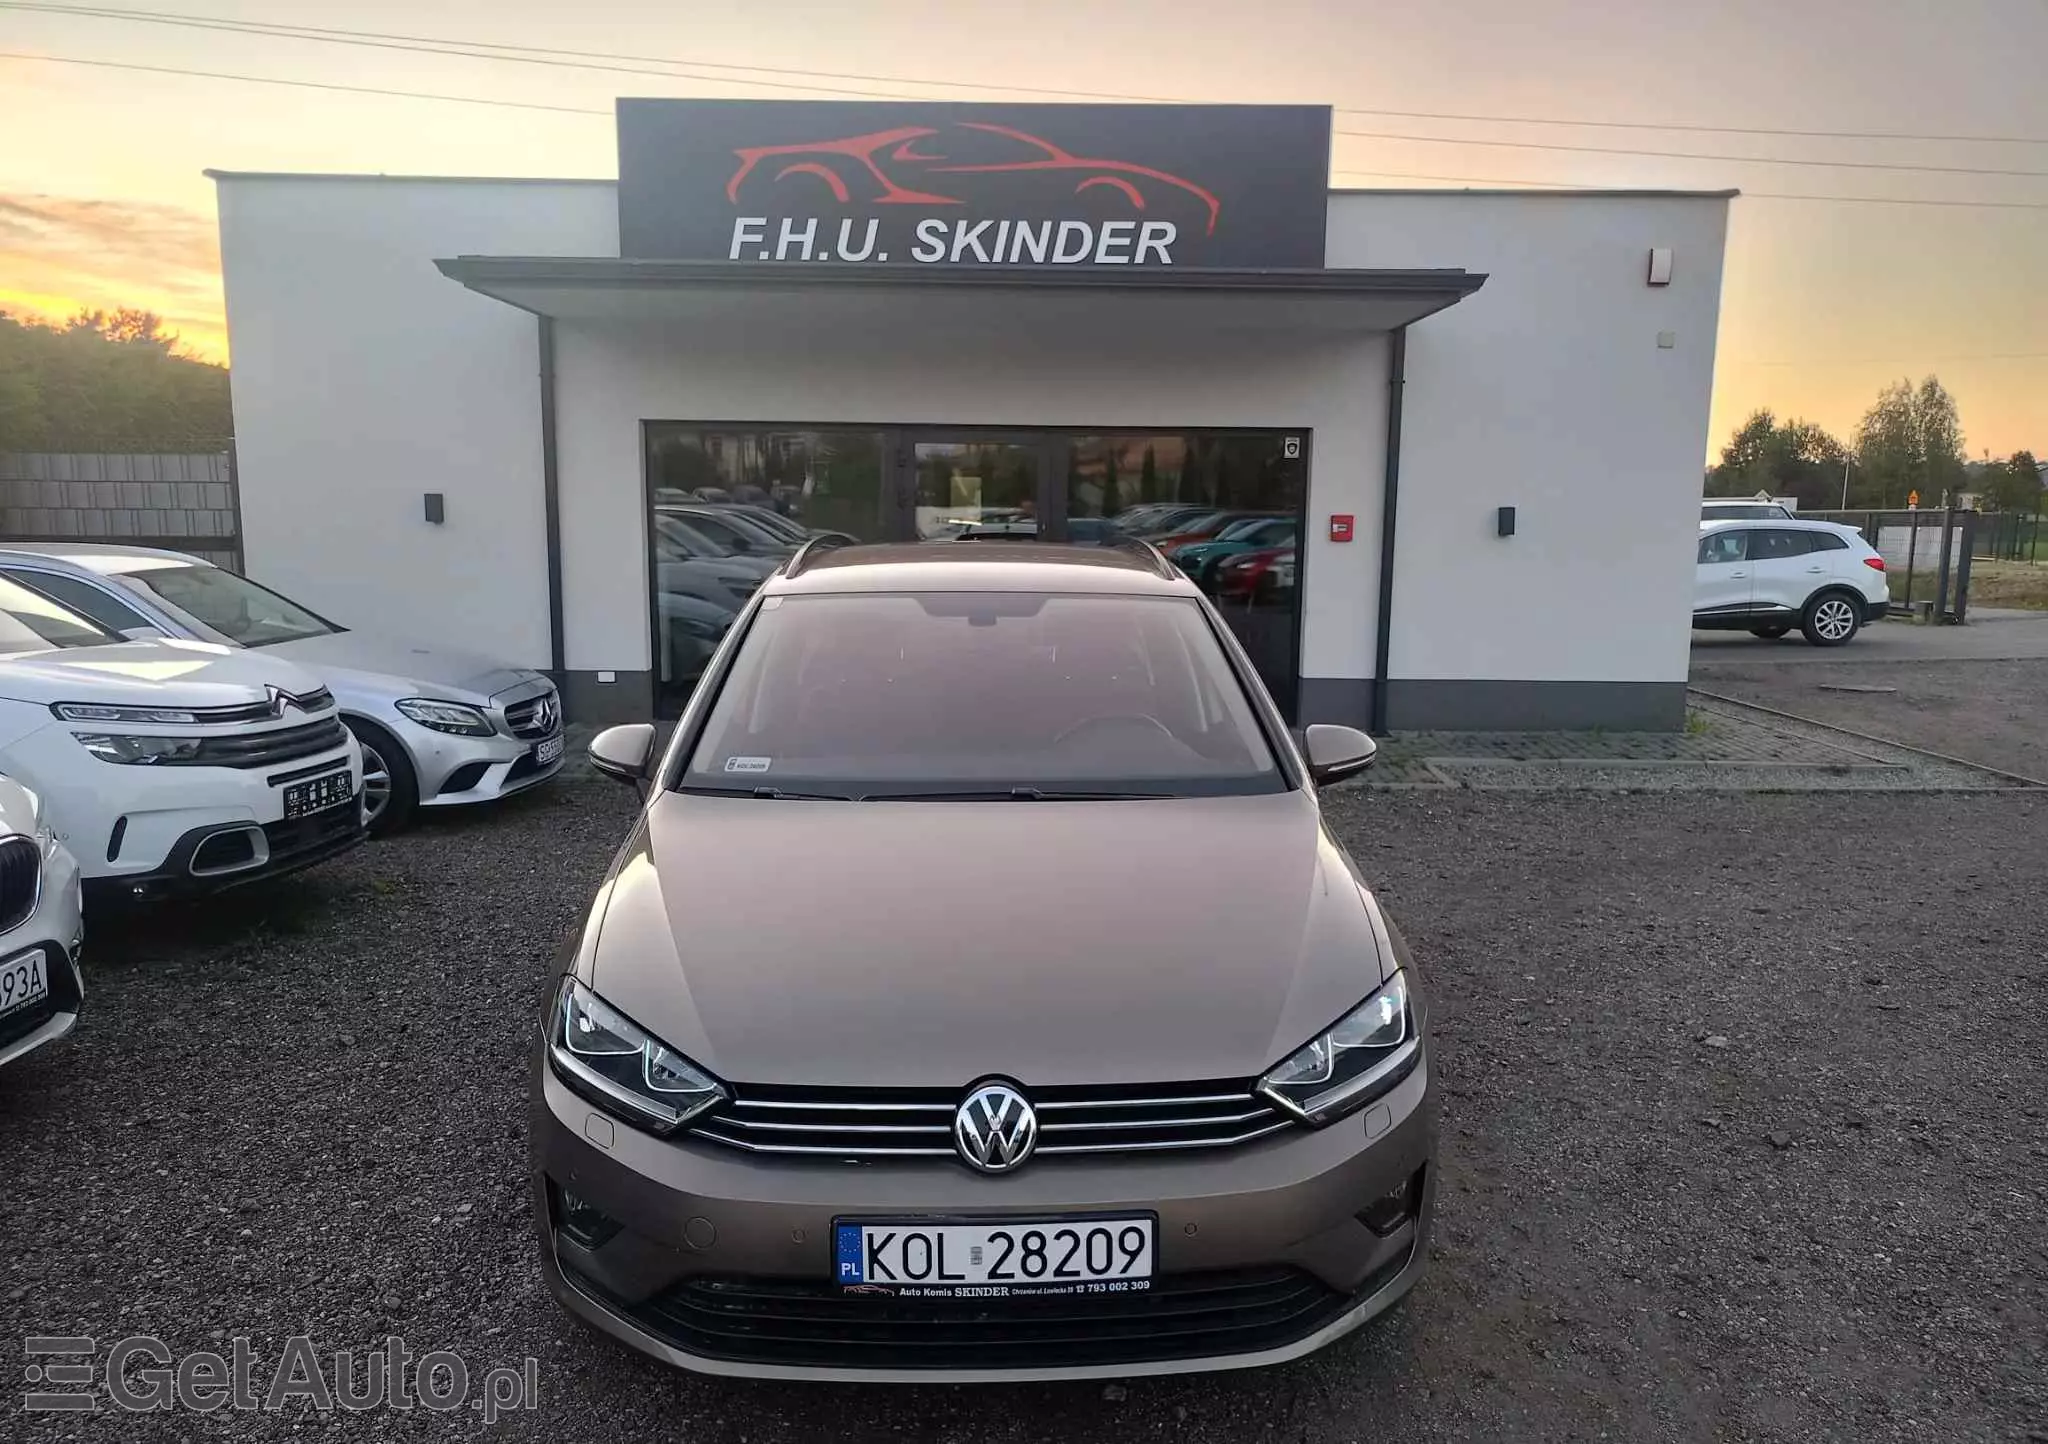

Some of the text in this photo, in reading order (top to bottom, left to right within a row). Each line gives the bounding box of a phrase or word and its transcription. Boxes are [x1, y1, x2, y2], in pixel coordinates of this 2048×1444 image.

[729, 217, 1177, 263] F.H.U. SKINDER
[0, 960, 41, 1007] 93A
[841, 1263, 859, 1277] PL
[866, 1226, 1146, 1281] KOL 28209
[899, 1287, 921, 1297] Auto
[923, 1287, 953, 1297] Komis
[954, 1286, 1010, 1297] SKINDER
[1087, 1283, 1106, 1293] 793
[1108, 1282, 1129, 1291] 002
[1131, 1280, 1151, 1290] 309
